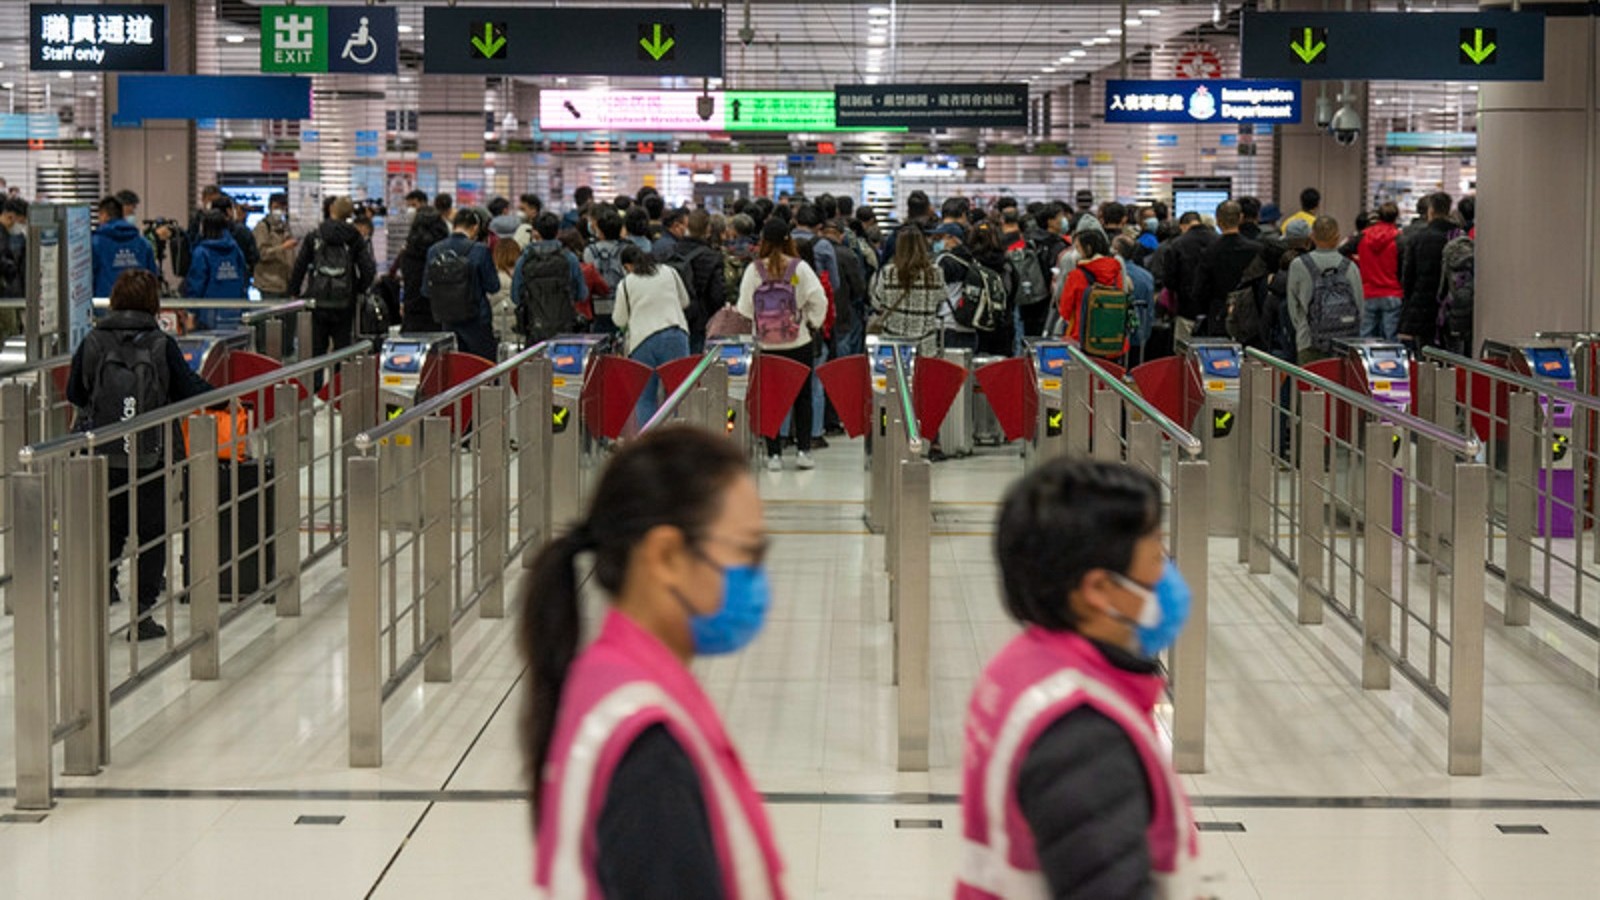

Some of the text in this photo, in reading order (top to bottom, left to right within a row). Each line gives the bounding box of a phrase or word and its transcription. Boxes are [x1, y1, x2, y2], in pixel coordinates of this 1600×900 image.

[41, 13, 153, 44] 職員通道
[274, 14, 313, 49] 出
[41, 45, 105, 64] Staff only
[274, 50, 313, 64] EXIT
[1110, 94, 1184, 111] 入境事務處
[1221, 87, 1294, 104] Immigration
[1221, 103, 1292, 120] Department
